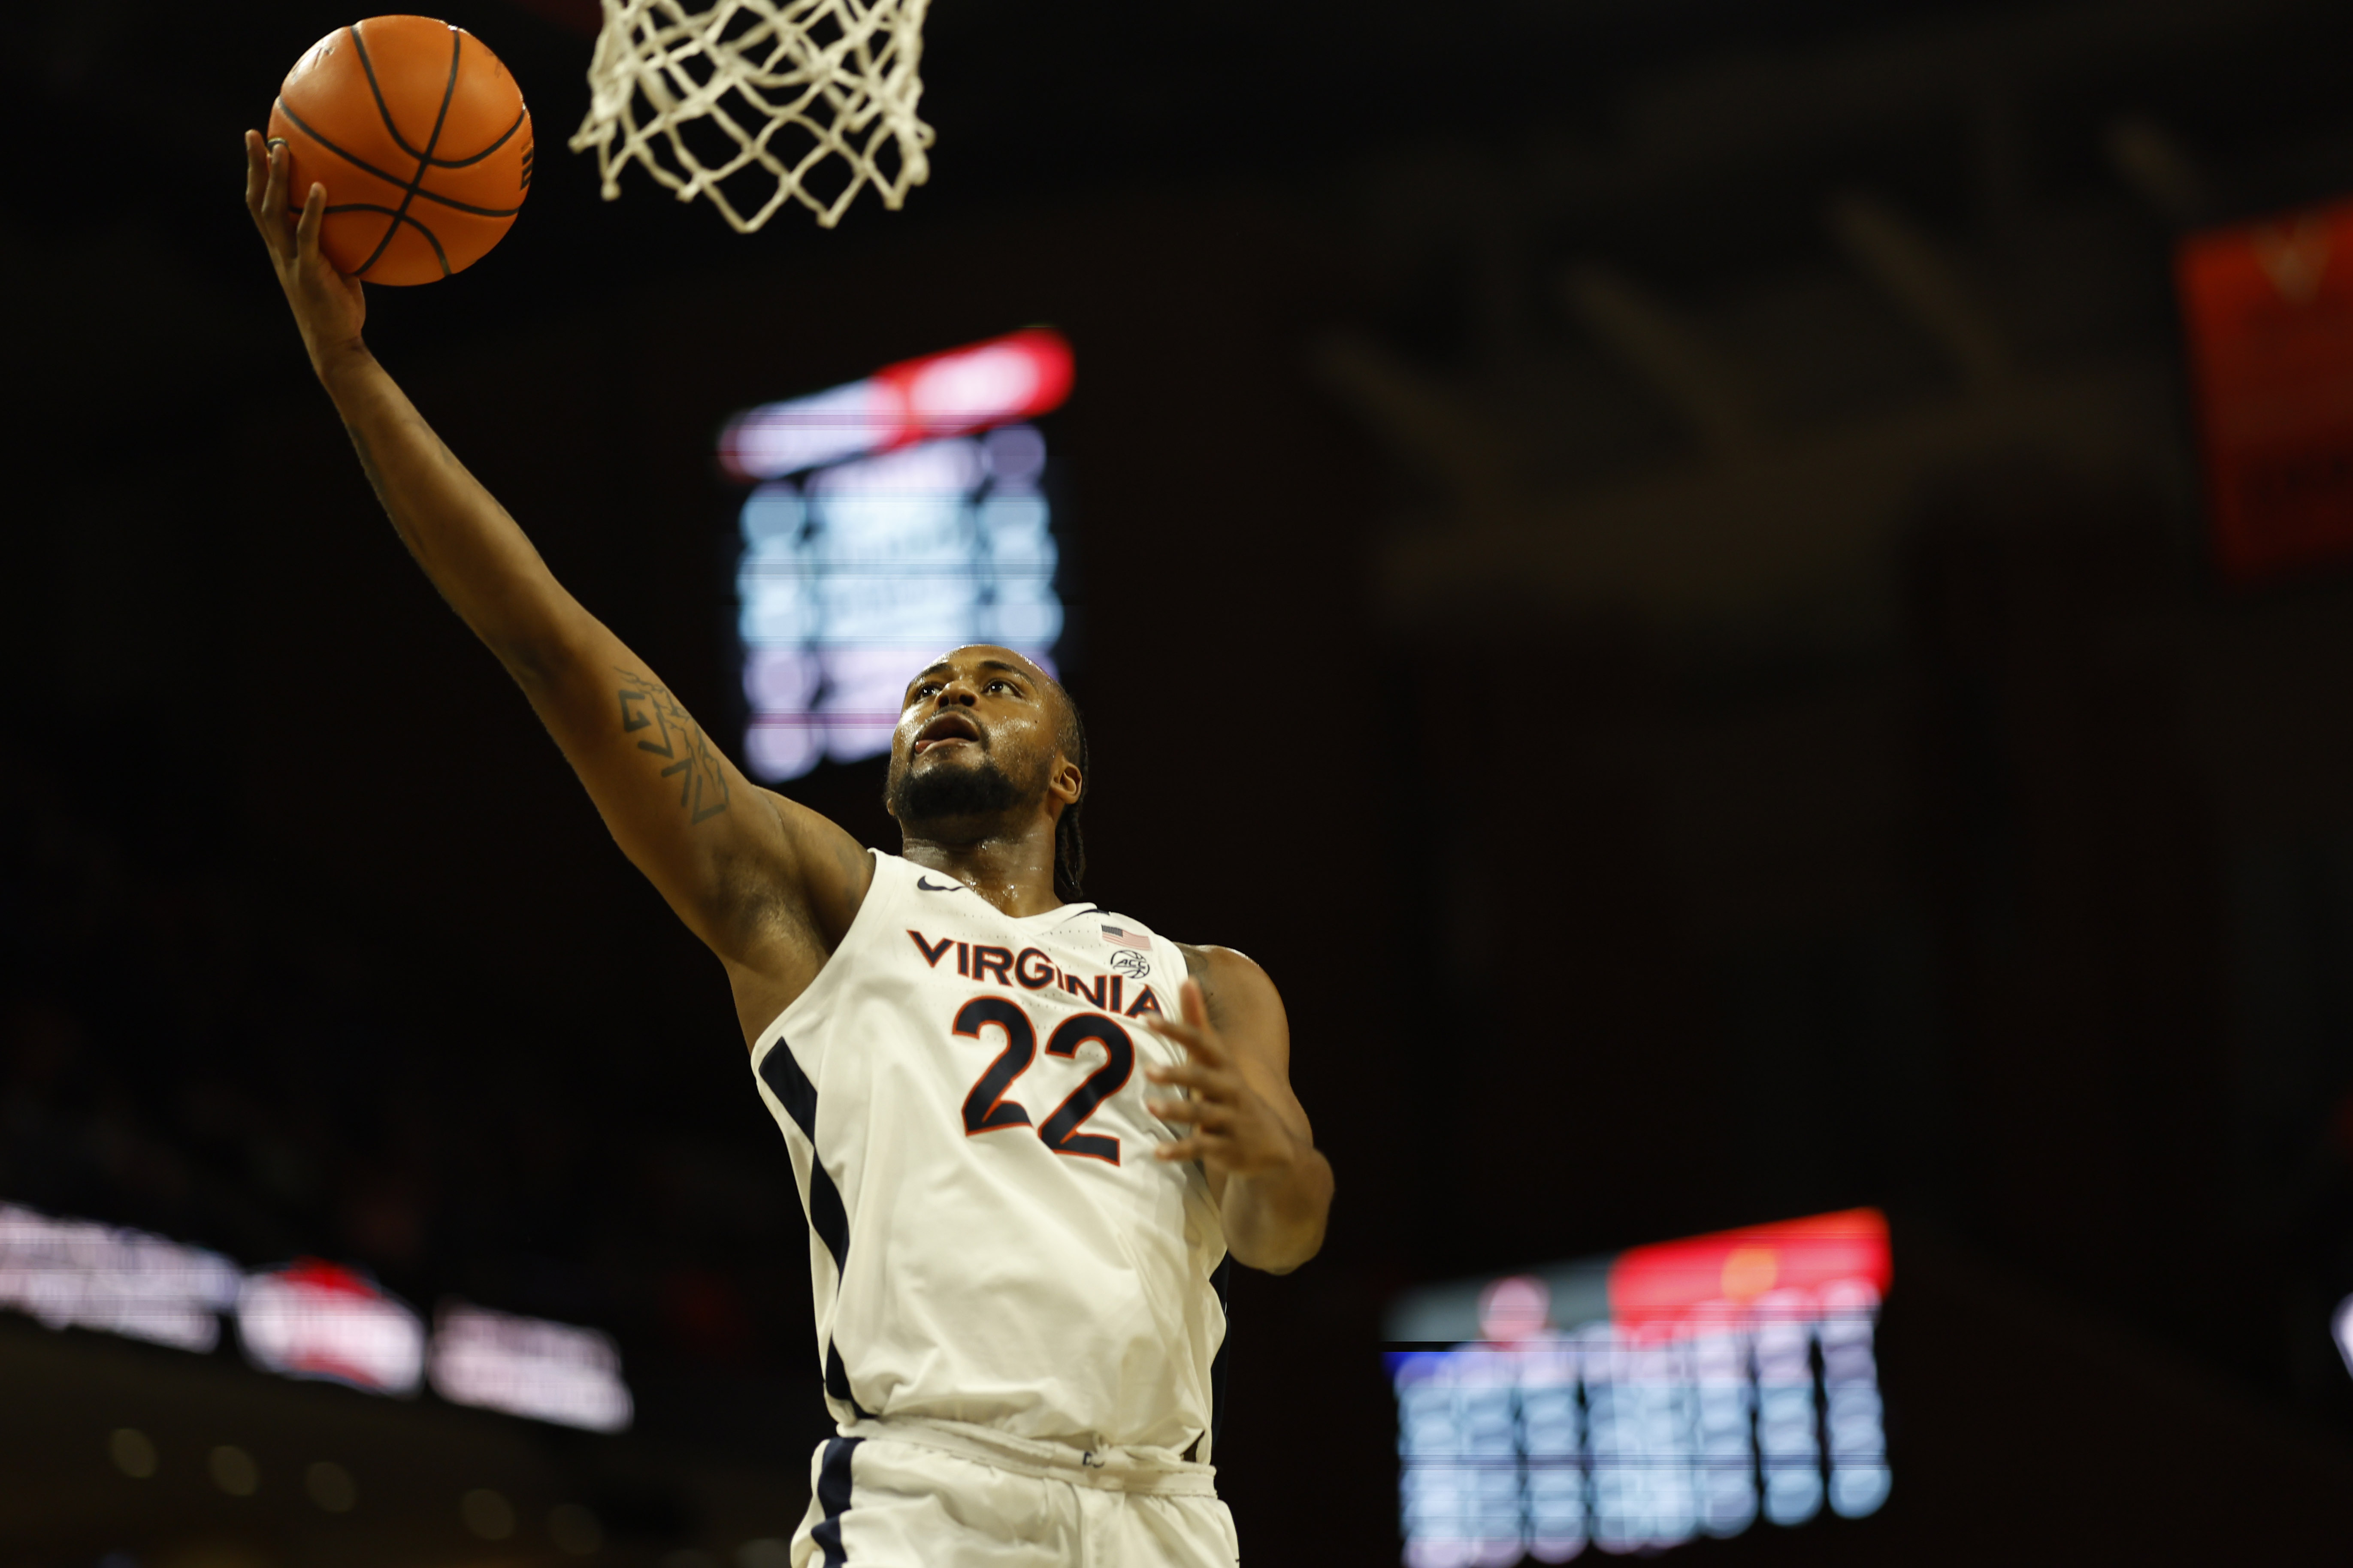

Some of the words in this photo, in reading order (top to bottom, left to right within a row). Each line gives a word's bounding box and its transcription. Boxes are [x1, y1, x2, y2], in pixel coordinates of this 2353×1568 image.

[906, 929, 1164, 1019] VIRGINIA
[1116, 958, 1146, 970] ACC
[952, 995, 1135, 1167] 22
